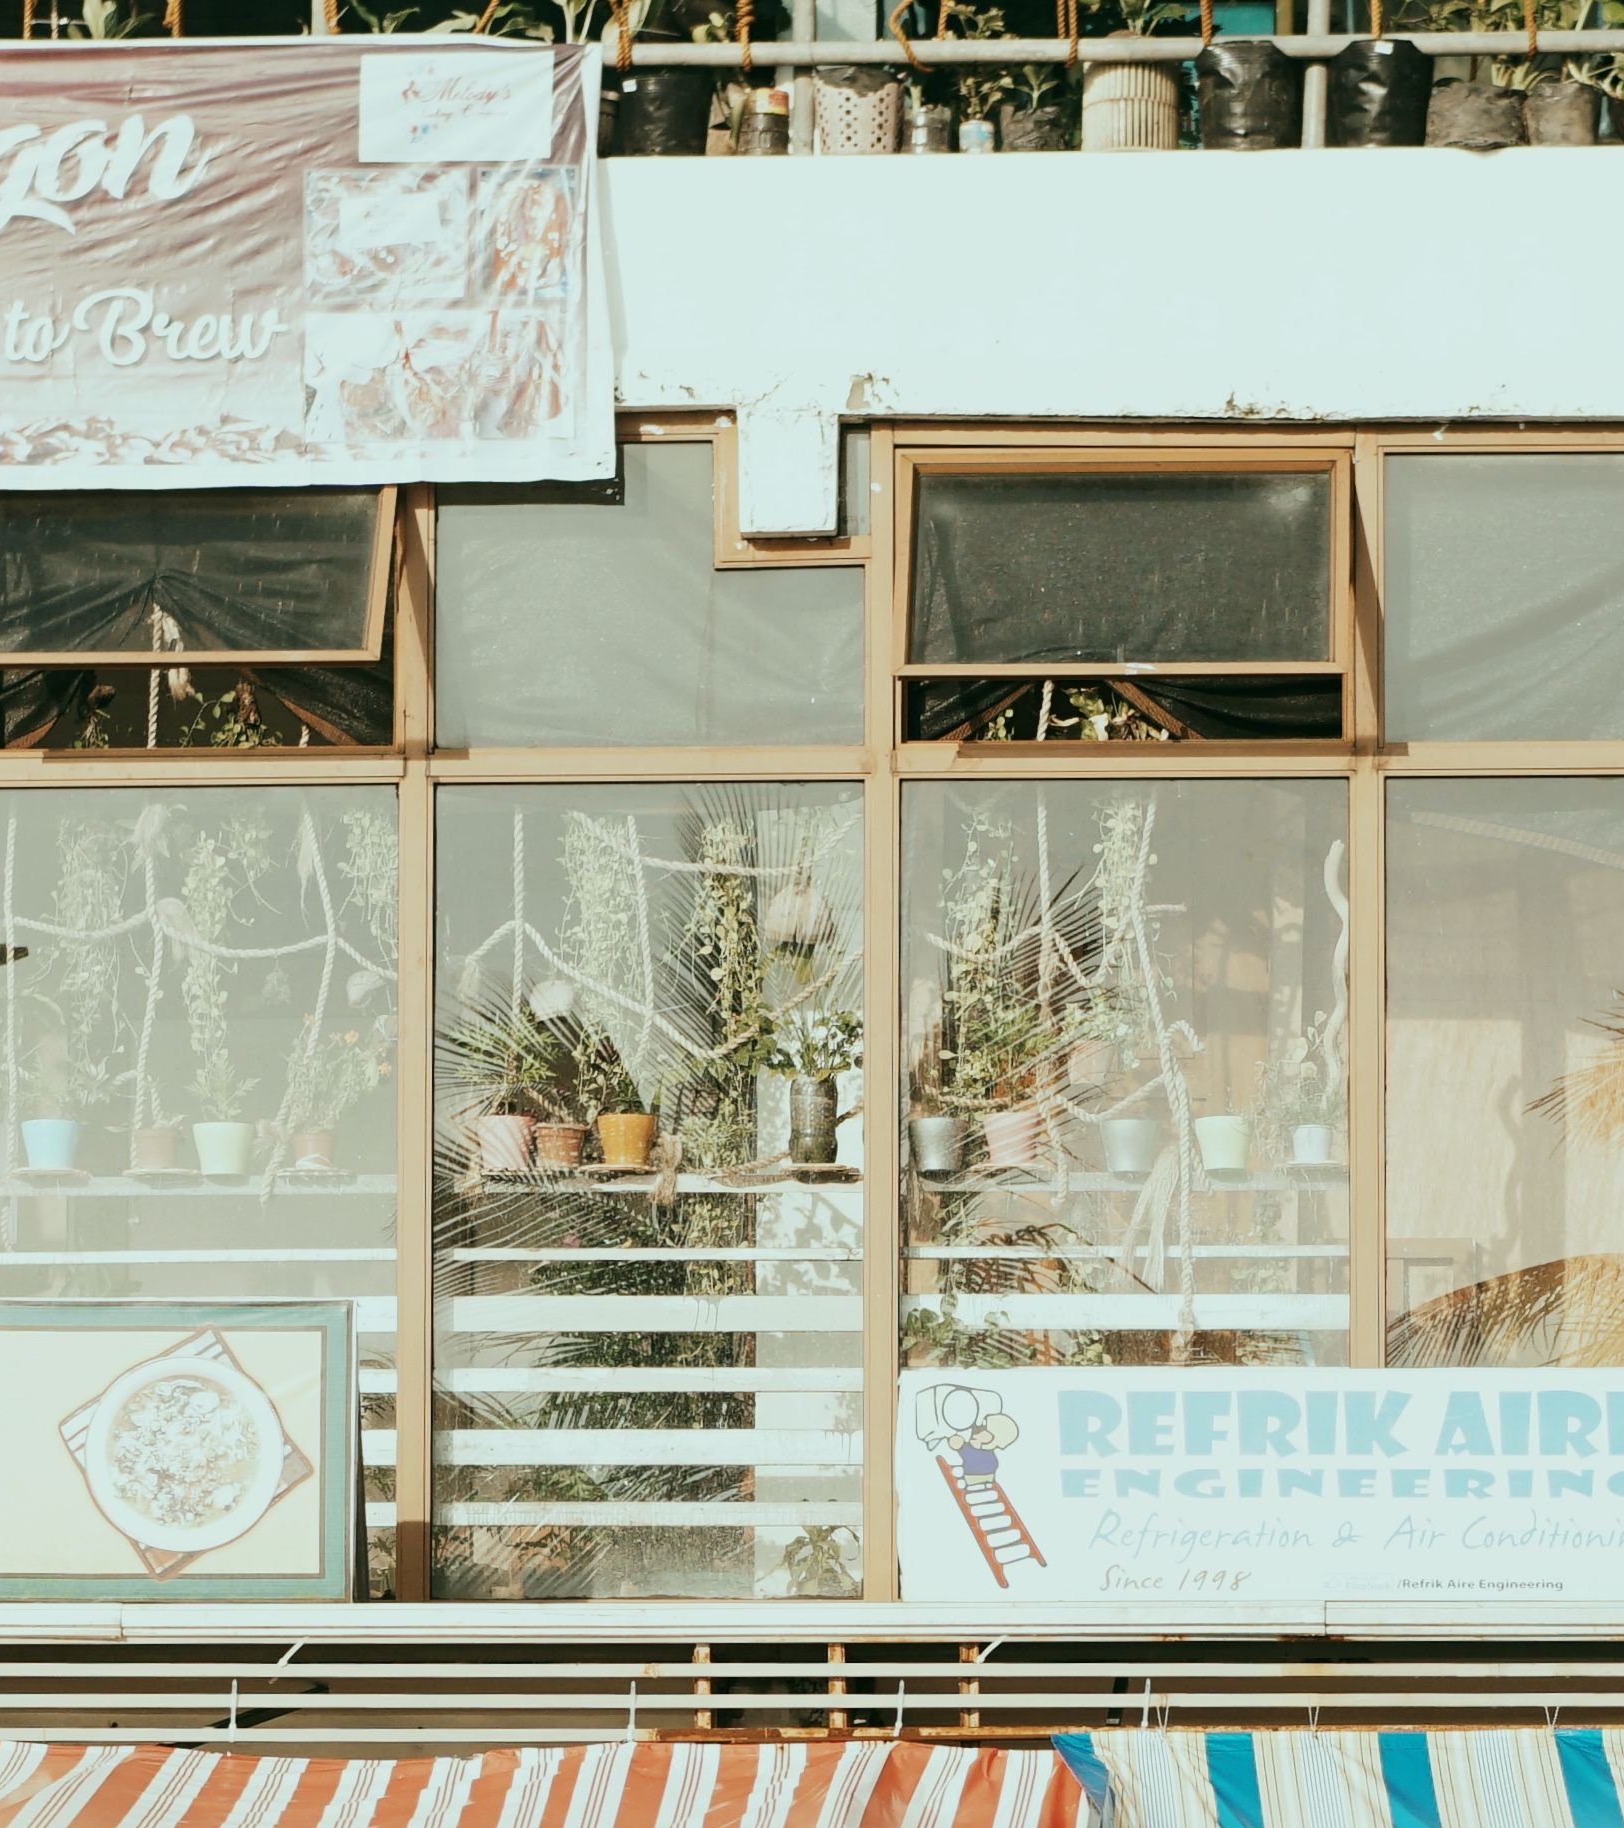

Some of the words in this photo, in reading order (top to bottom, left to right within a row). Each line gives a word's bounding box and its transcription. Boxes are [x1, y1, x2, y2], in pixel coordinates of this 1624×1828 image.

[3, 298, 69, 364] to
[72, 286, 301, 367] Brew
[1057, 1389, 1413, 1459] REFRIK
[1089, 1508, 1313, 1565] Refrigeration
[1332, 1522, 1362, 1548] &
[1383, 1515, 1446, 1551] Air
[1102, 1565, 1164, 1592] Since
[1178, 1566, 1253, 1593] 1998
[1446, 1579, 1476, 1591] Aire
[1478, 1578, 1564, 1593] Engineering
